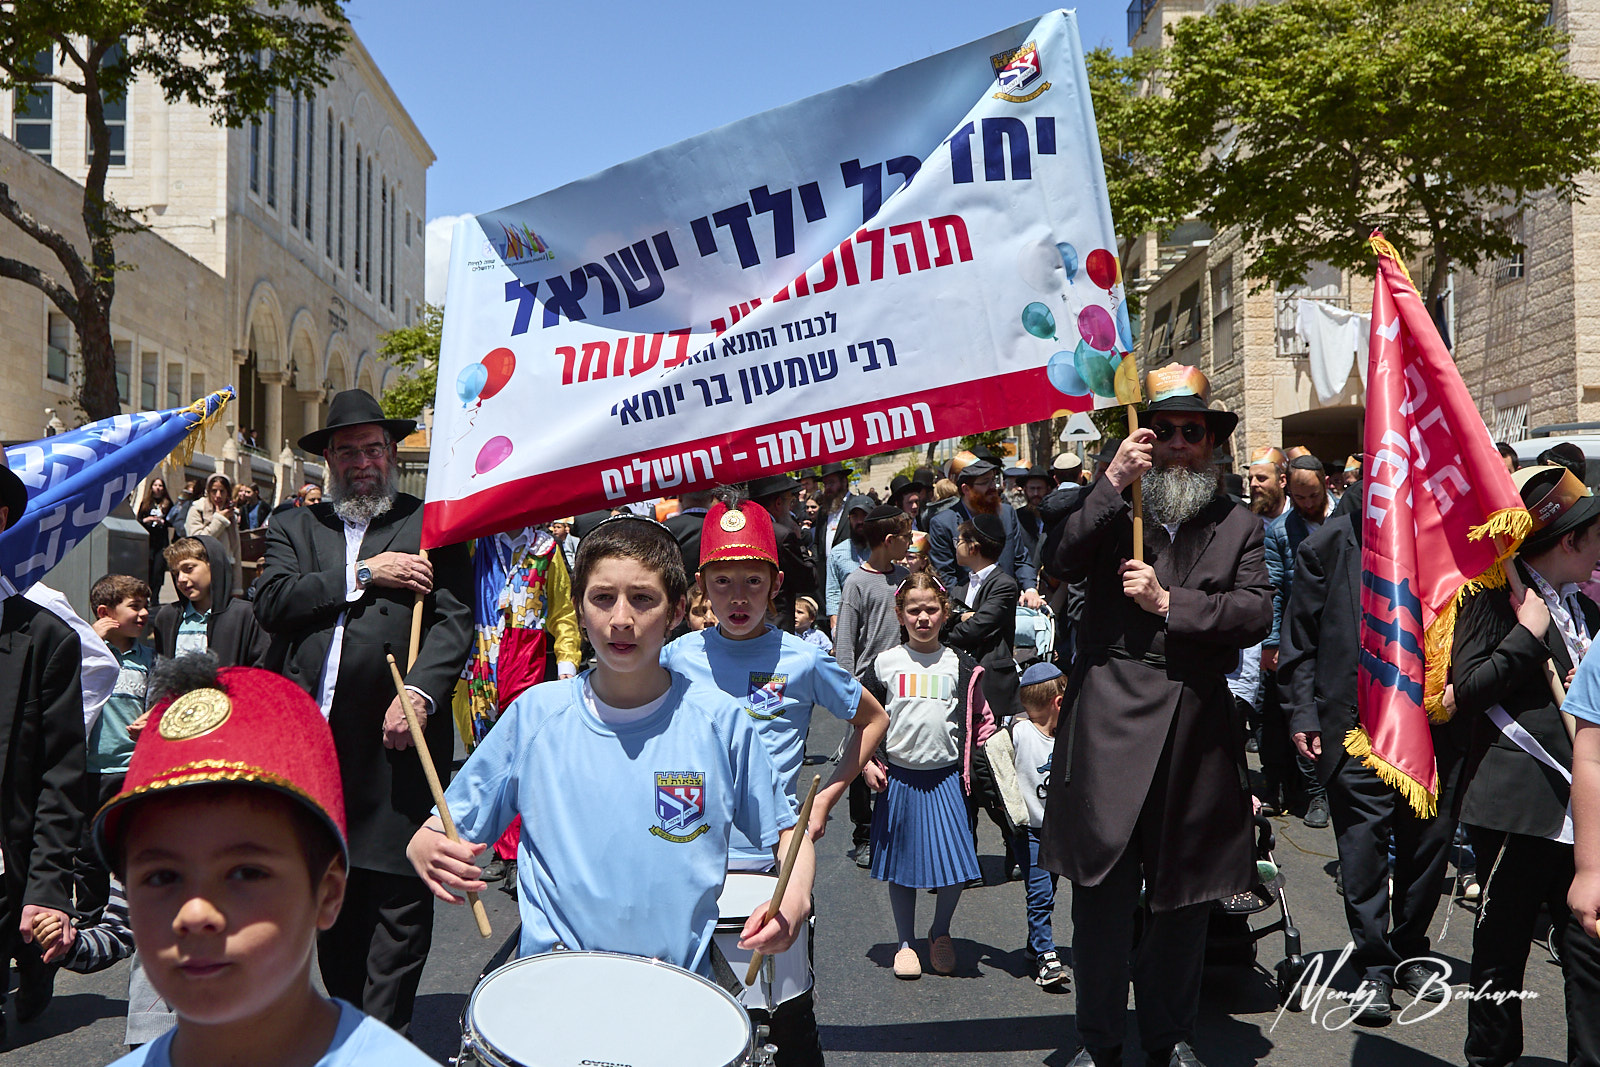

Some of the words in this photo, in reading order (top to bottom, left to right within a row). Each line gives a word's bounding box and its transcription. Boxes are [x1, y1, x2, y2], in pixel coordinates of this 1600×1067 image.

[943, 117, 1056, 184] יחד
[840, 155, 922, 224] כל
[690, 181, 827, 269] ילדי
[505, 230, 679, 336] ישראל
[722, 327, 777, 357] התנא
[781, 311, 837, 342] לכבוד
[555, 327, 692, 385] בעומר
[738, 348, 839, 405] שמעון
[847, 337, 898, 372] רבי
[692, 373, 733, 407] בר
[755, 417, 855, 468] שלמה
[862, 402, 935, 445] רמת
[600, 445, 722, 500] ירושלים
